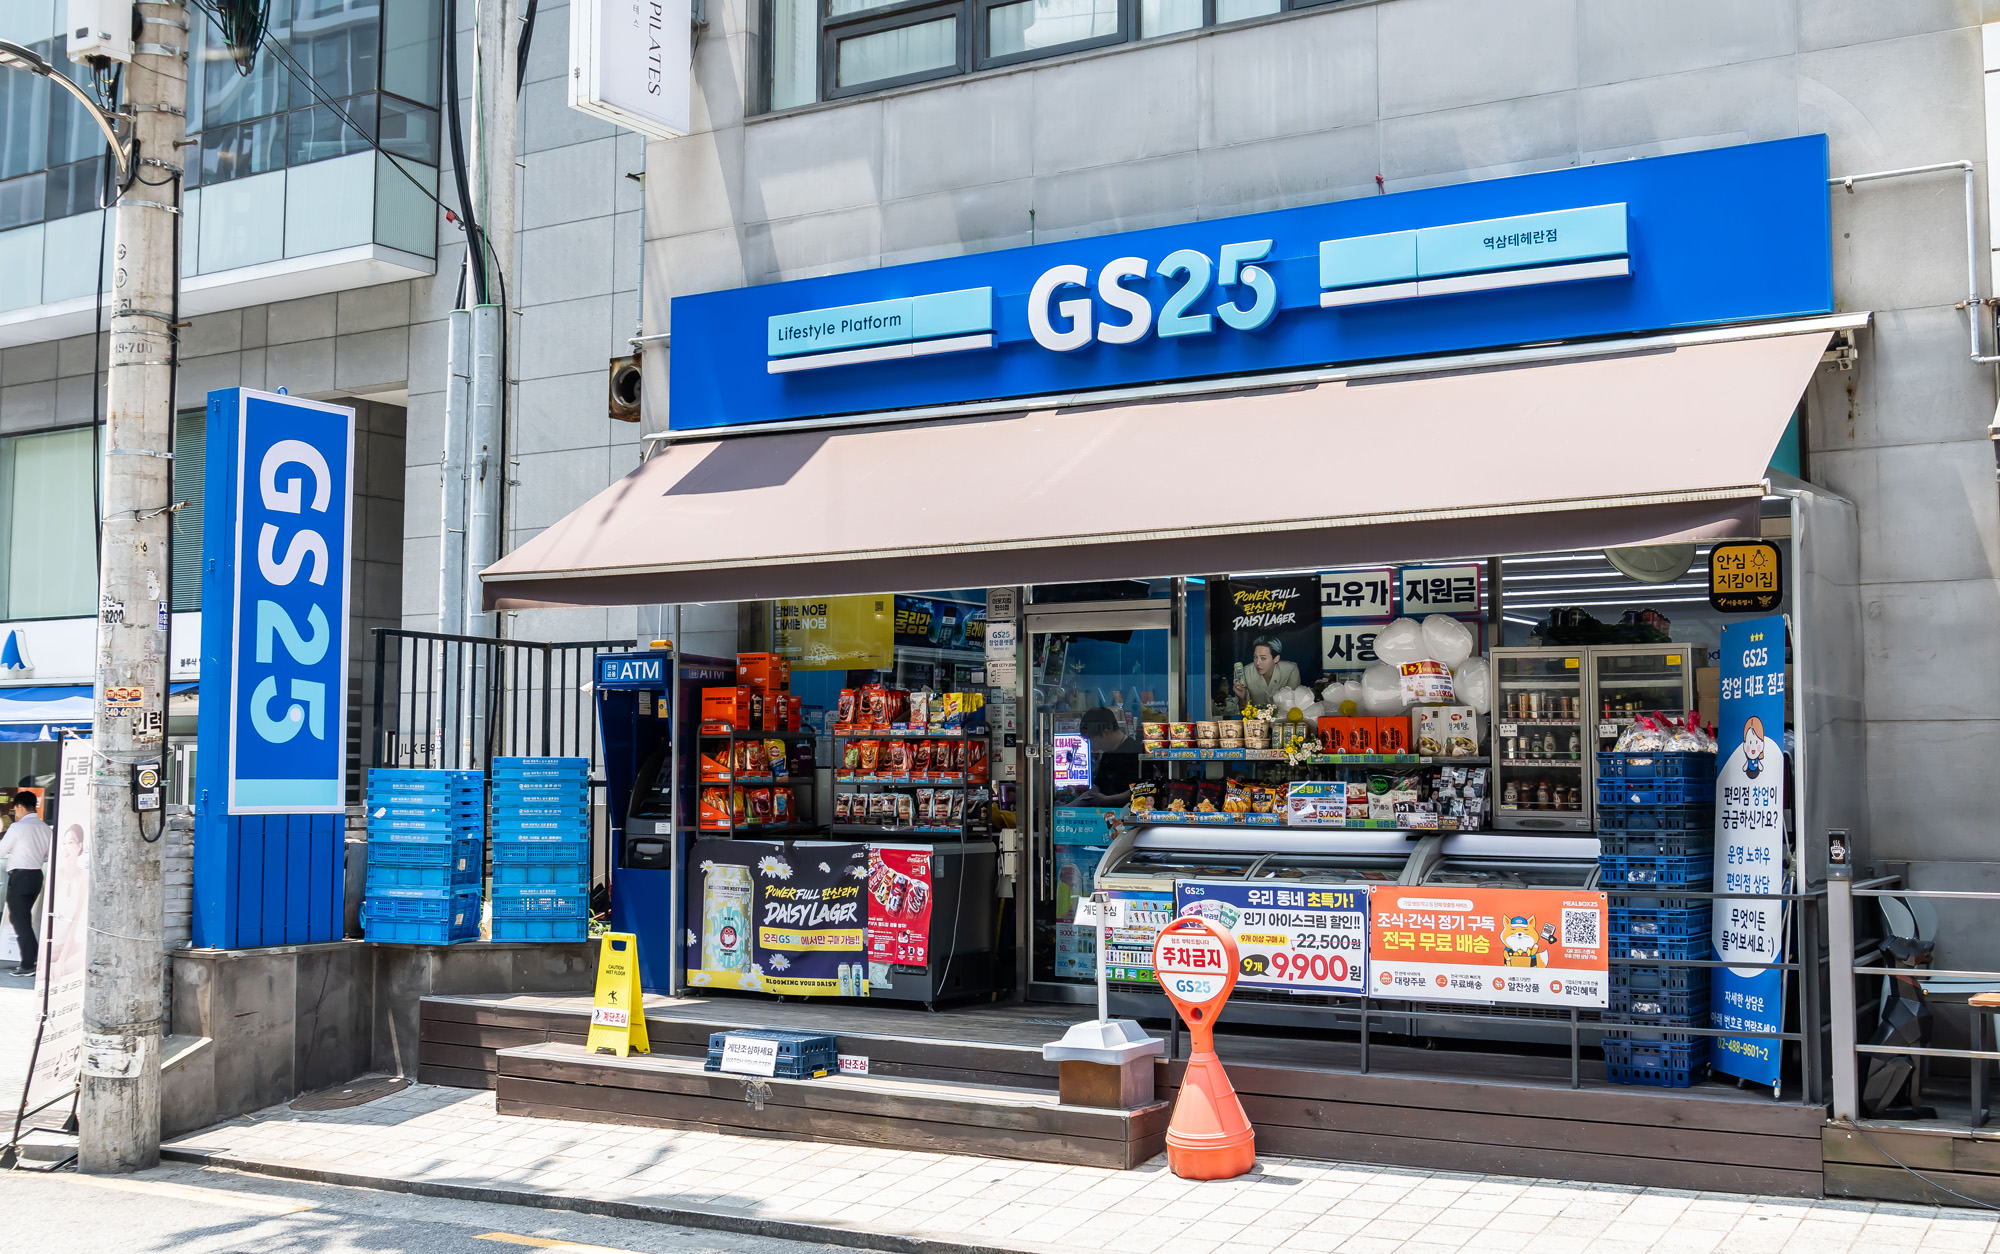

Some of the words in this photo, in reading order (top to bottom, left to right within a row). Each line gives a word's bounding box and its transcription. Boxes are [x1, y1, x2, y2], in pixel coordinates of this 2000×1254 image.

[648, 1, 662, 96] PILATES
[1483, 228, 1558, 250] 역삼테헤란점
[1028, 239, 1278, 352] GS25
[777, 317, 835, 342] Lifestyle
[841, 313, 902, 332] Platform
[1717, 553, 1746, 570] 안심
[1718, 571, 1773, 589] 지킴이집
[250, 439, 331, 744] GS25
[1322, 580, 1388, 607] 고유가
[1406, 577, 1476, 604] 지원금
[1742, 647, 1768, 668] GS25
[620, 661, 659, 679] ATM
[1401, 662, 1422, 675] 1+1
[1721, 676, 1742, 700] 창업
[1745, 674, 1764, 697] 대표
[1767, 672, 1784, 695] 점포
[1724, 786, 1750, 806] 편의점
[1752, 786, 1777, 806] 창업이
[1722, 810, 1779, 829] 궁금하신가요?
[1727, 845, 1744, 865] 운영
[1746, 846, 1771, 866] 노하우
[821, 886, 860, 900] 탄산라거
[1185, 886, 1205, 895] GS25
[1726, 872, 1751, 894] 편의점
[1753, 874, 1770, 895] 상담
[1248, 889, 1274, 907] 우리
[1276, 889, 1304, 908] 동네
[1307, 891, 1355, 909] 초특가!
[763, 902, 812, 926] DAISY
[808, 902, 858, 926] LAGER
[1243, 912, 1266, 927] 인기
[1268, 912, 1327, 929] 아이스크림
[1330, 914, 1361, 930] 할인!!
[1377, 912, 1435, 929] 조식·간식
[1437, 914, 1464, 931] 정기
[1467, 915, 1496, 932] 구독
[1731, 908, 1766, 931] 무엇이든
[763, 933, 778, 944] 오직
[1240, 934, 1251, 943] 9개
[1252, 935, 1263, 944] 이상
[1264, 935, 1278, 944] 구매
[1279, 936, 1285, 944] 시
[1296, 933, 1362, 950] 22,500원
[1383, 931, 1415, 951] 전국
[1419, 932, 1453, 952] 무료
[1456, 934, 1490, 954] 배송
[1722, 930, 1765, 953] 물어보세요
[1163, 947, 1221, 968] 주차금지
[1243, 958, 1263, 973] 9개
[766, 978, 799, 986] BLOOMING
[816, 979, 837, 987] DAISY
[1176, 980, 1211, 993] GS25
[1395, 976, 1426, 987] 대량주문
[1451, 979, 1483, 990] 무료배송
[1507, 982, 1540, 993] 알찬상품
[1565, 985, 1598, 996] 할인혜택
[1725, 991, 1743, 1009] 자세한
[1744, 994, 1765, 1013] 상담은
[603, 1011, 627, 1024] 계단조심
[1724, 1015, 1743, 1031] 번호로
[727, 1043, 774, 1056] 계단조심하세요
[1717, 1036, 1769, 1061] 02-488-9601~2
